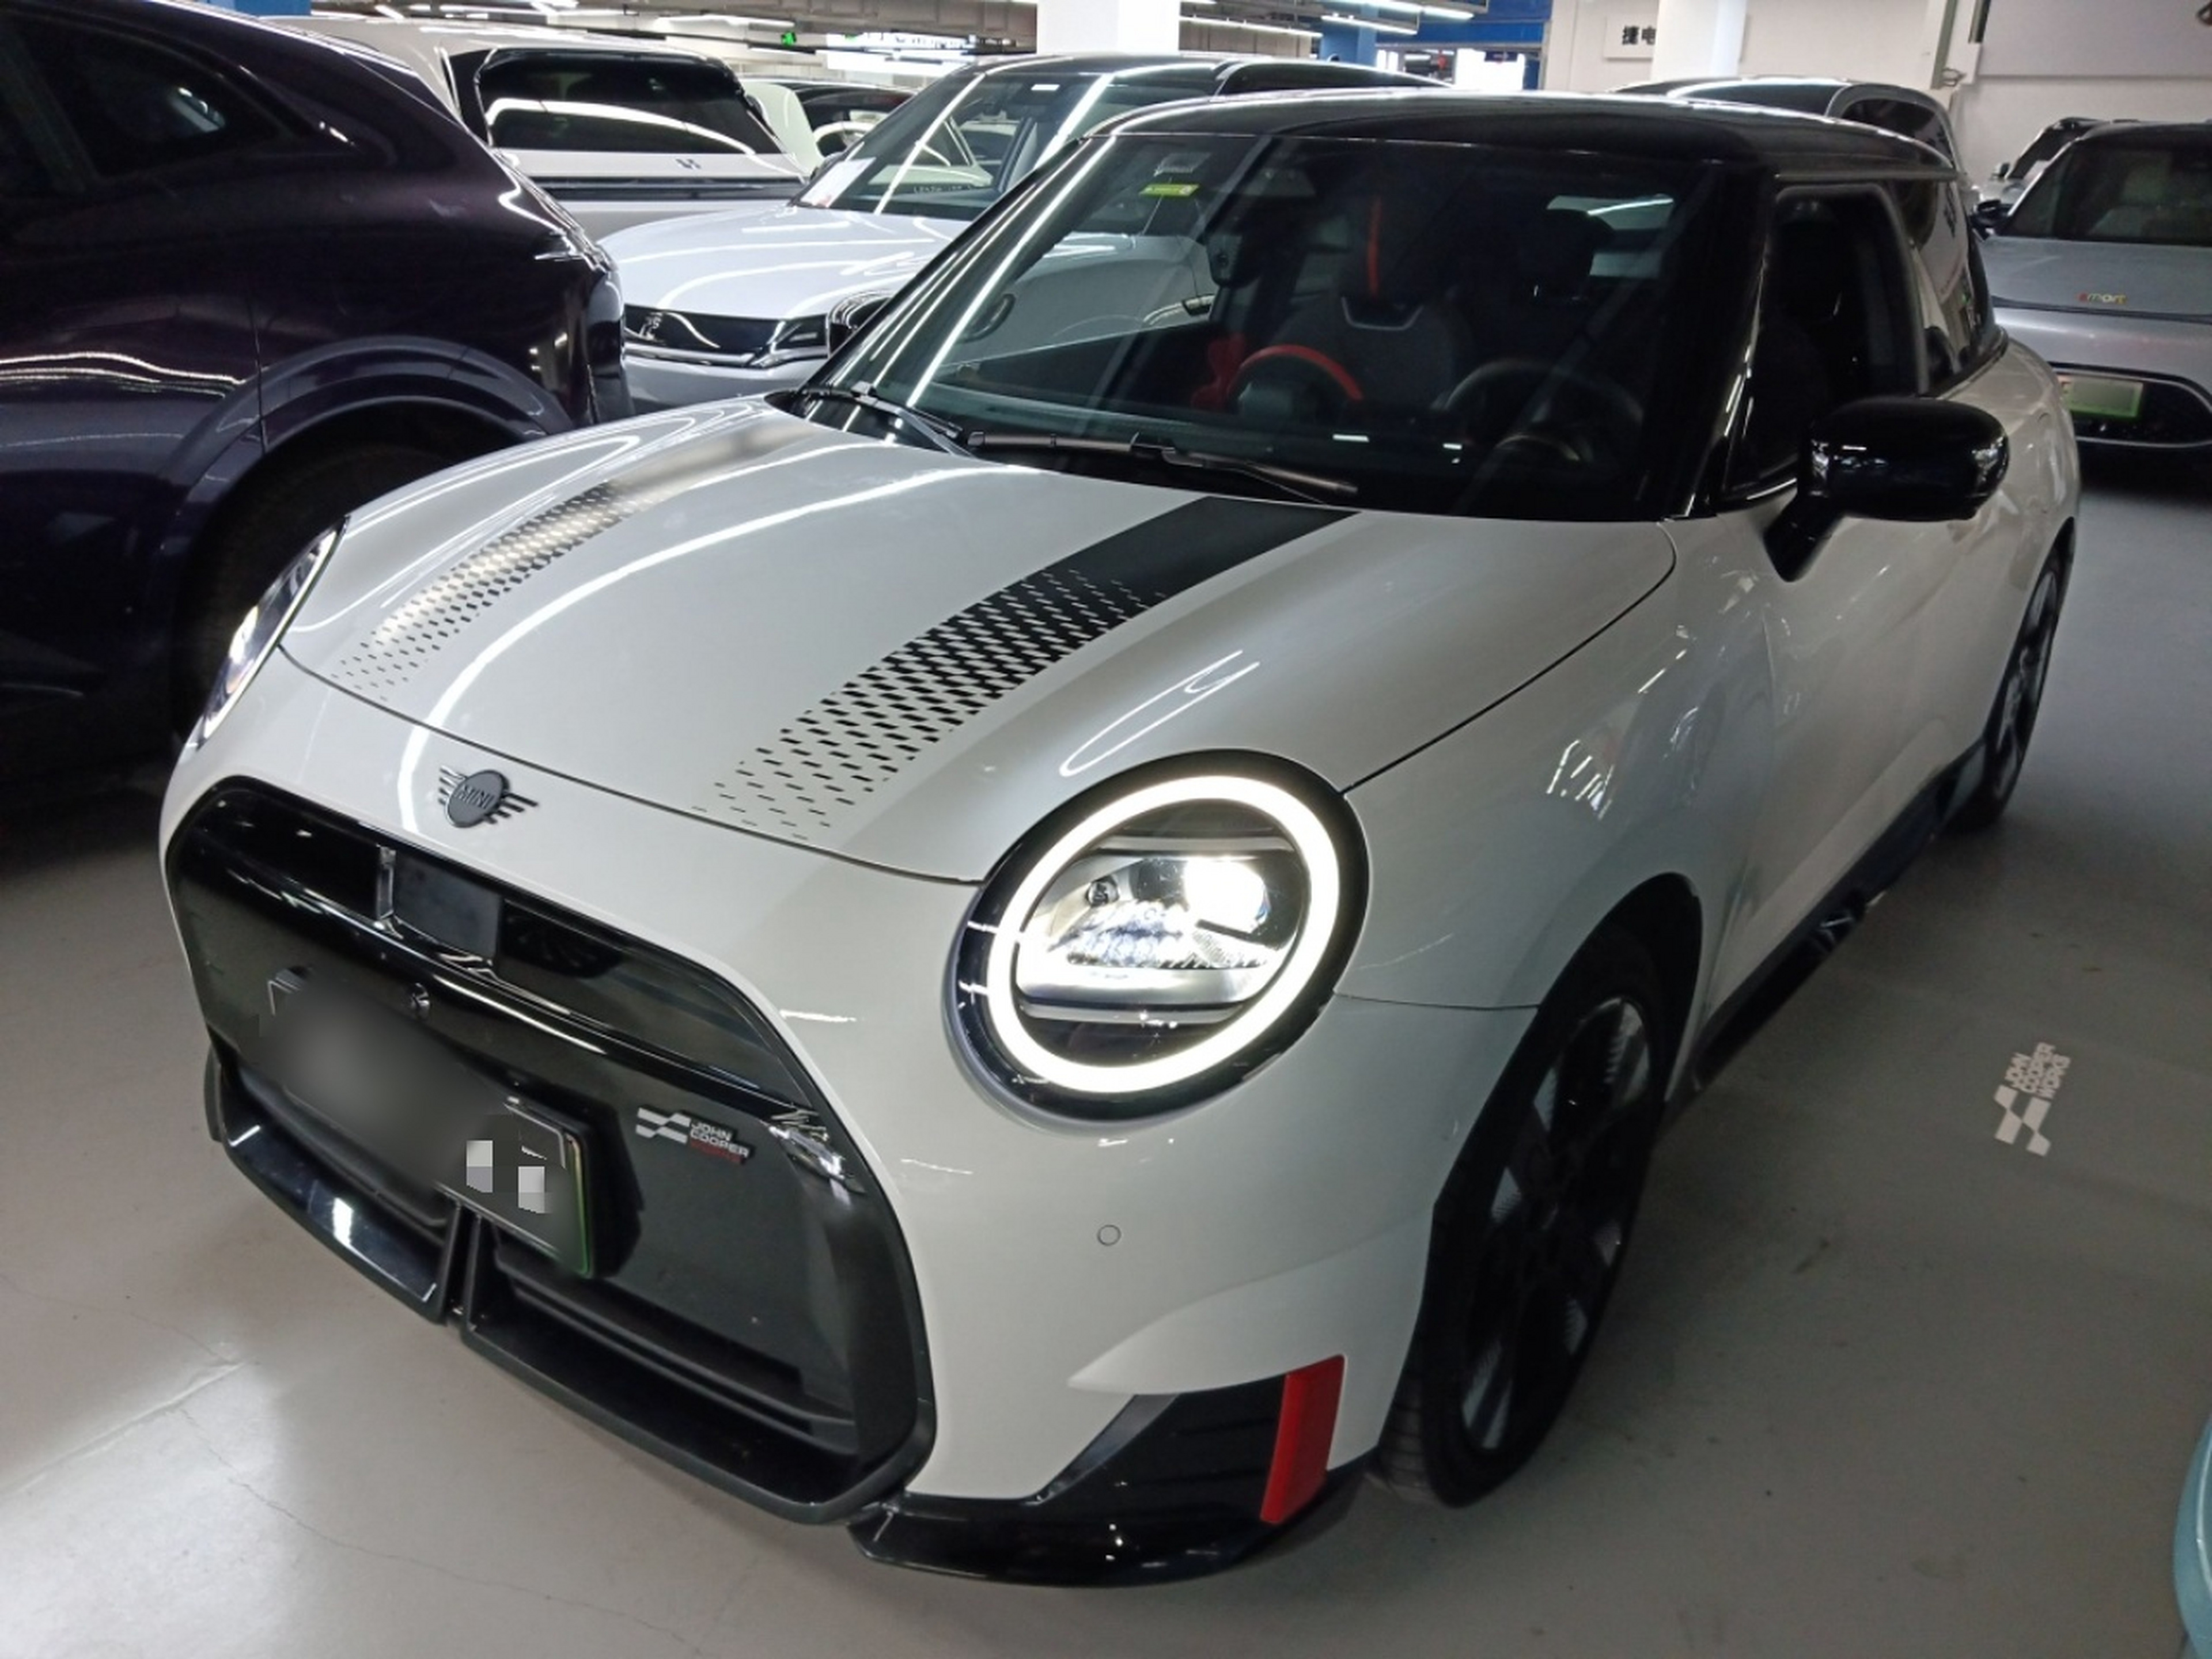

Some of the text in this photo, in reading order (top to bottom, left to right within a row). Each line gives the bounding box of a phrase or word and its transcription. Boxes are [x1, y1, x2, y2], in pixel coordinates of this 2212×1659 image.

[454, 785, 495, 809] MINI
[690, 1129, 749, 1158] COOPER
[691, 1122, 733, 1141] JOHN
